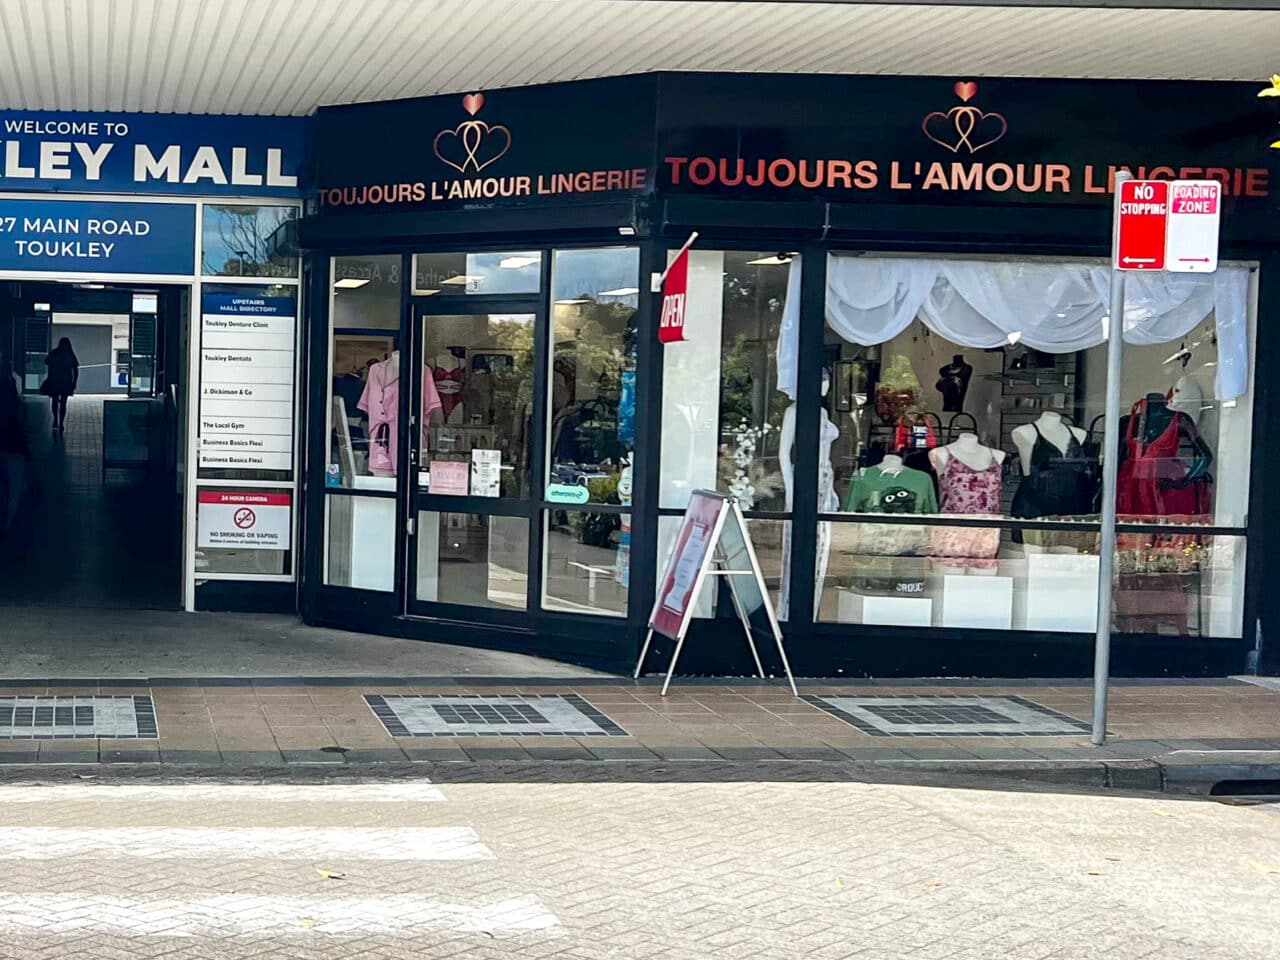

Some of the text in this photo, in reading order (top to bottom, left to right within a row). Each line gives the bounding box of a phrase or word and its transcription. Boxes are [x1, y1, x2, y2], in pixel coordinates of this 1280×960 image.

[4, 119, 129, 137] WELCOME TO
[134, 144, 298, 187] MALL
[664, 156, 878, 190] TOUJOURS
[890, 160, 1071, 193] L'AMOUR
[318, 168, 646, 206] TOUJOURS L'AMOUR LINGERIE
[1133, 186, 1154, 200] NO
[1173, 186, 1217, 199] LOADING
[1121, 202, 1166, 215] STOPPING
[1178, 200, 1211, 213] ZONE
[23, 217, 81, 235] MAIN
[86, 219, 151, 237] ROAD
[15, 239, 115, 258] TOUKLEY
[660, 293, 685, 328] OPEN
[205, 320, 227, 328] Toukley
[205, 354, 227, 362] Toukley
[231, 422, 245, 430] Gym
[550, 490, 576, 499] afterpay
